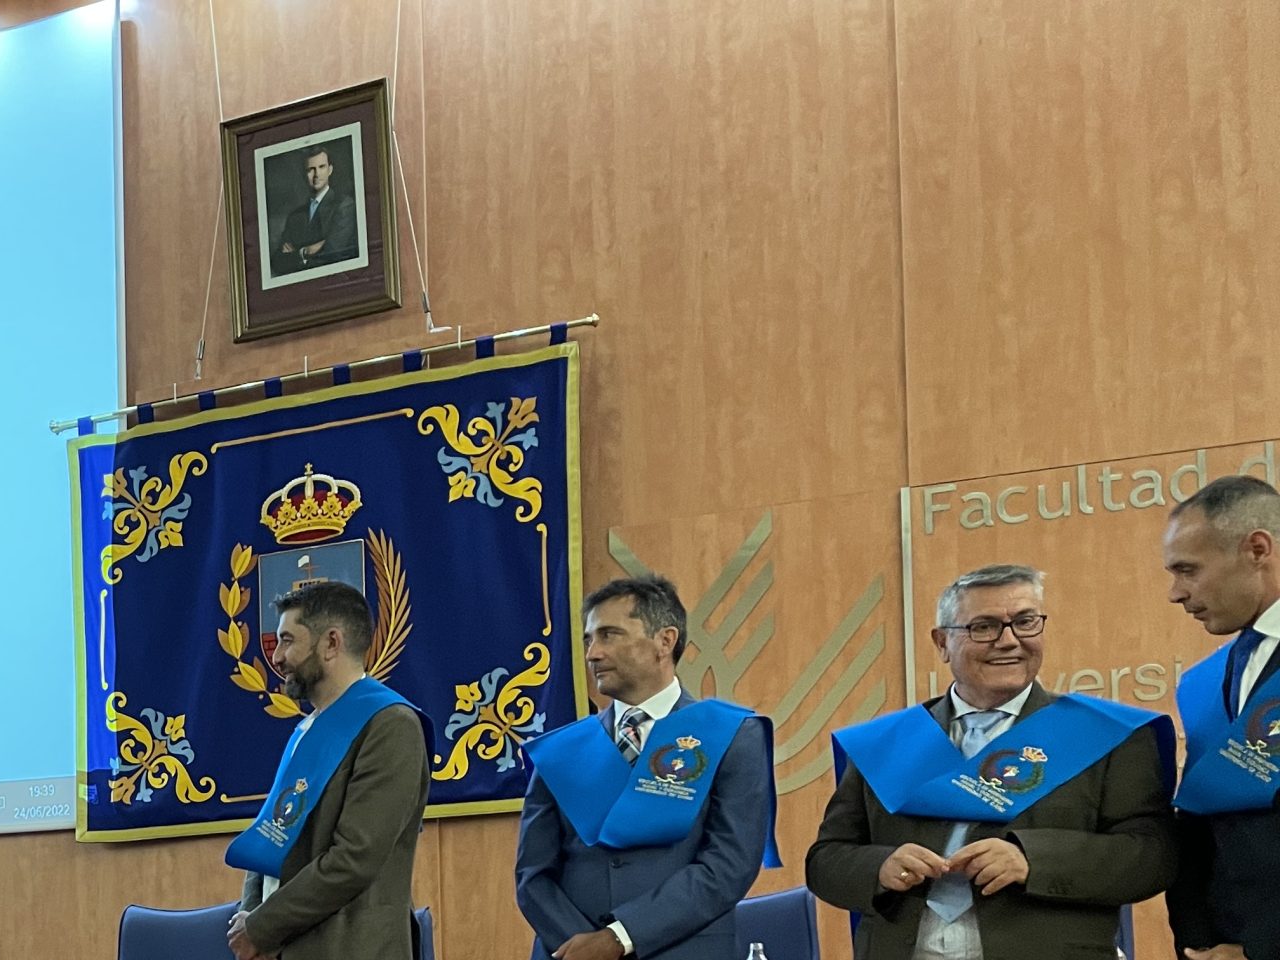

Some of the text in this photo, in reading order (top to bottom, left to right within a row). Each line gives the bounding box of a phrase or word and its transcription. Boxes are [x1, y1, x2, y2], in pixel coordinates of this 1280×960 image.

[923, 449, 1207, 534] Facultad
[28, 784, 55, 797] 19:39
[14, 804, 70, 819] 24/06/2022
